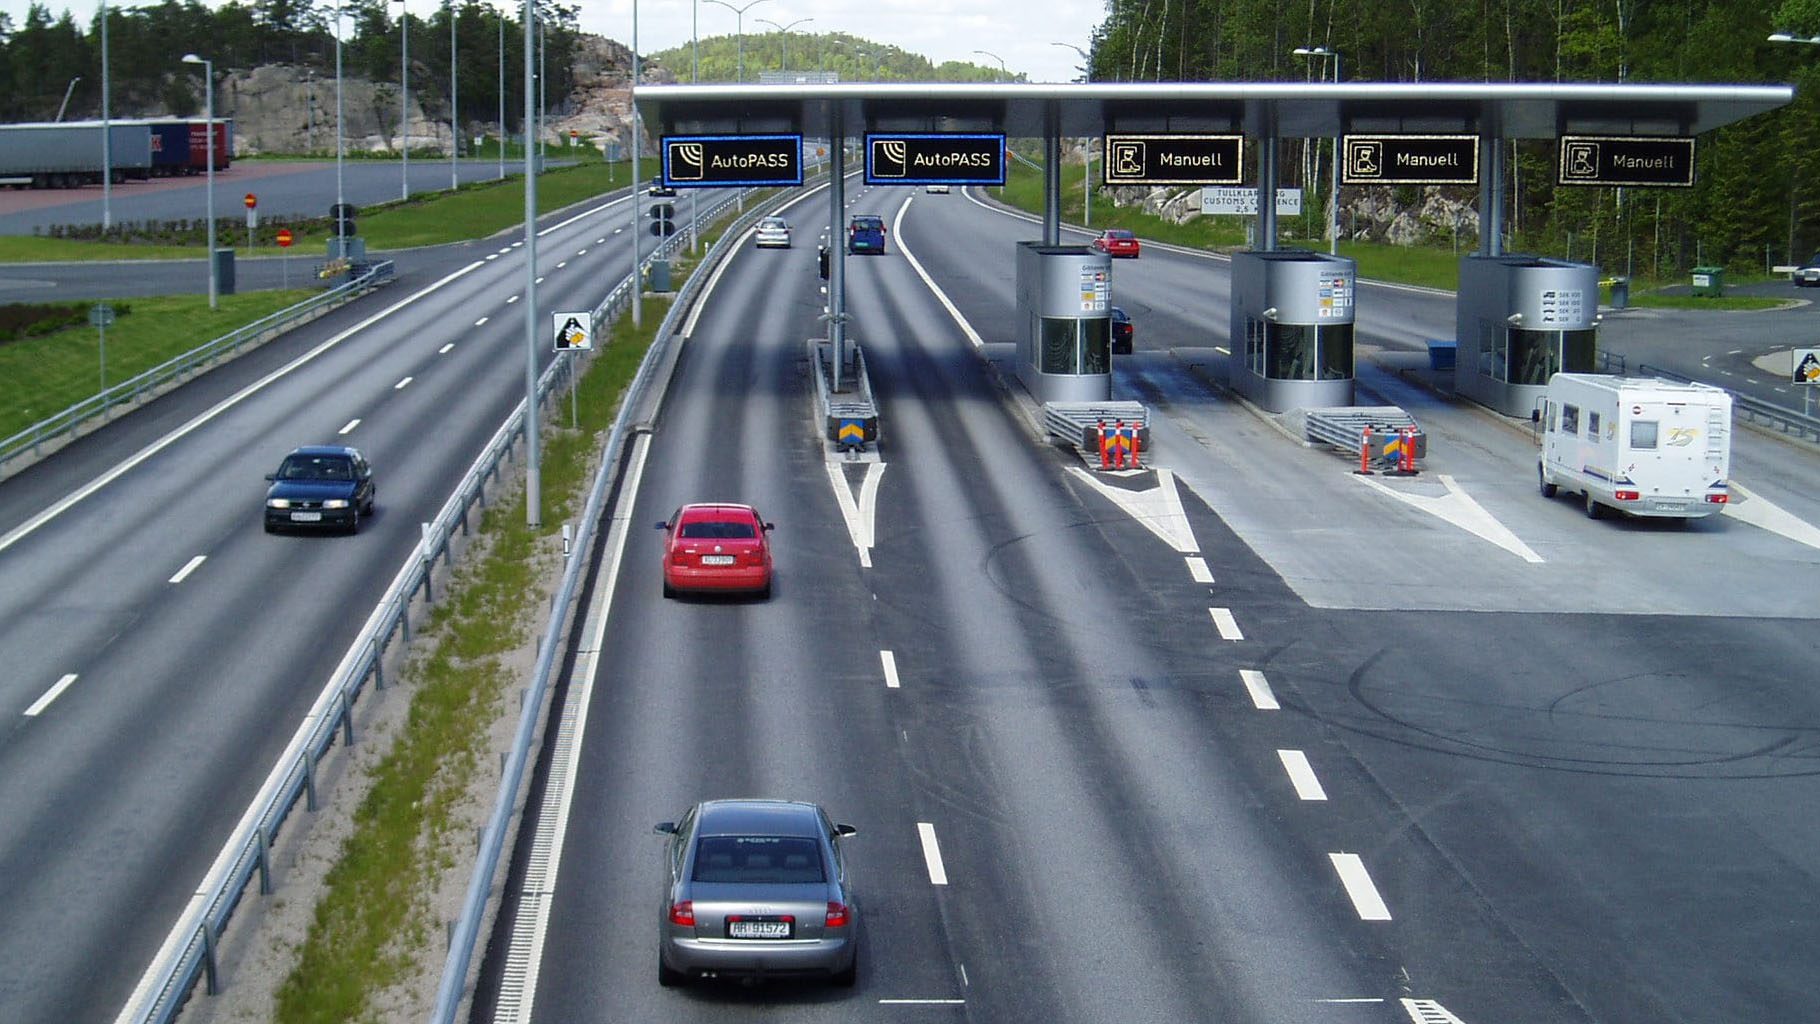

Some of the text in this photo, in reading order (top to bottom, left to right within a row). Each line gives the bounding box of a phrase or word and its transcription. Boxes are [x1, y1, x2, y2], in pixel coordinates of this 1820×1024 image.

[711, 153, 789, 168] AutoPASS
[913, 152, 991, 167] AutoPASS
[1160, 152, 1223, 167] Manuell
[1396, 152, 1459, 167] Manuell
[1613, 154, 1675, 169] Manuell
[1203, 198, 1245, 206] CUSTOMS
[752, 922, 788, 934] 91572
